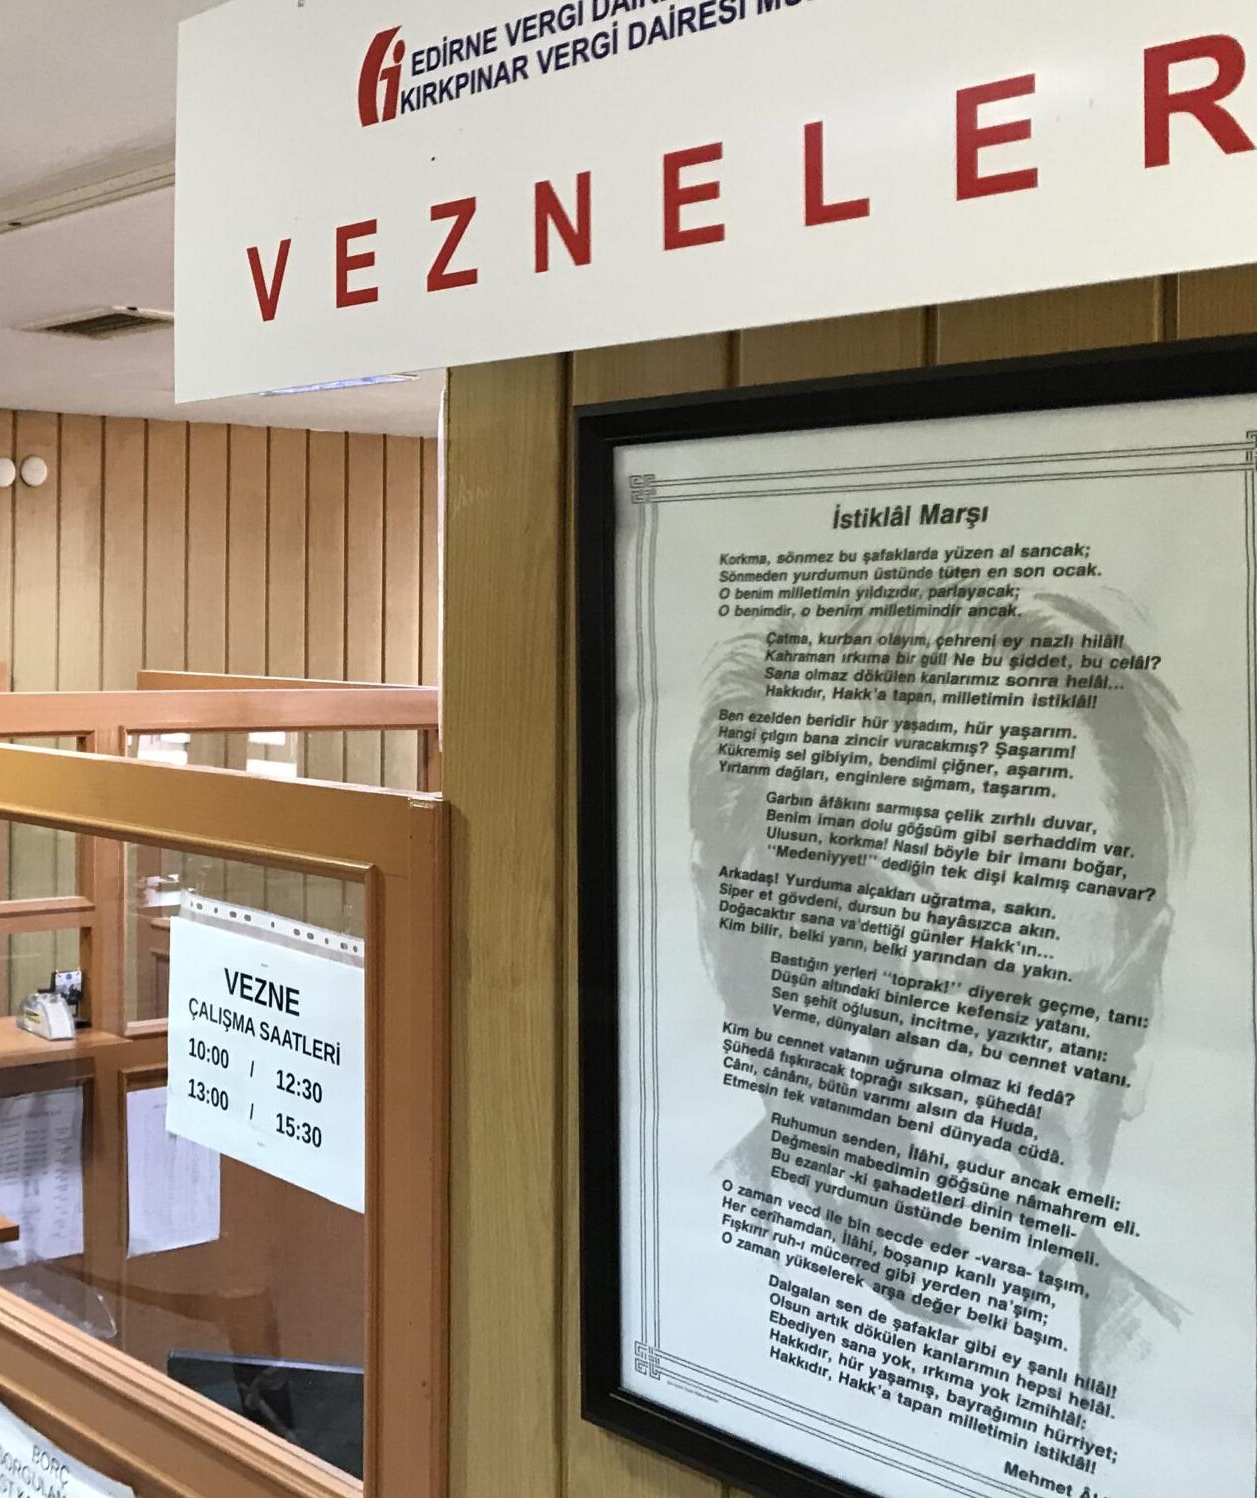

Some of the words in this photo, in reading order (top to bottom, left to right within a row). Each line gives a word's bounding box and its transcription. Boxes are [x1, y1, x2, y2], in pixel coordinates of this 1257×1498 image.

[401, 55, 529, 115] KIRKPINAR
[537, 20, 618, 75] VERGİ
[412, 27, 498, 77] EDİRNE
[247, 34, 1256, 321] VEZNELER
[832, 503, 911, 529] İstiklâl
[919, 503, 988, 529] Marşı
[719, 569, 788, 582] Sönmeden
[792, 568, 868, 584] yurdumun
[873, 566, 933, 580] üstünde
[938, 566, 981, 581] tüten
[986, 567, 1007, 579] en
[1013, 566, 1045, 578] son
[1052, 562, 1101, 577] ocak.
[776, 551, 834, 564] sönmez
[838, 550, 857, 562] bu
[862, 547, 938, 565] şafaklarda
[943, 546, 994, 563] yüzen
[999, 544, 1015, 558] al
[1020, 542, 1090, 558] sancak;
[718, 587, 730, 599] O
[734, 587, 773, 599] benim
[778, 586, 850, 599] milletimin
[855, 585, 922, 601] yıldızıdır,
[927, 583, 1020, 601] parlayacak;
[718, 708, 744, 721] Ben
[748, 711, 801, 725] ezelden
[806, 713, 856, 727] beridir
[861, 715, 889, 729] hür
[893, 719, 957, 735] yaşadım,
[964, 720, 993, 735] hür
[999, 725, 1076, 740] yaşarım.
[718, 725, 756, 743] Hangi
[760, 729, 797, 745] çılgın
[802, 731, 839, 745] bana
[844, 733, 889, 747] zincir
[894, 738, 989, 757] vuracakmış?
[994, 741, 1076, 760] Şaşarım!
[718, 743, 781, 762] Kükremiş
[785, 748, 806, 761] sel
[810, 750, 872, 767] gibiyim,
[878, 753, 937, 770] bendimi
[941, 758, 998, 776] çiğner,
[1006, 764, 1073, 779] aşarım.
[719, 760, 770, 776] Yırtarım
[775, 765, 828, 782] dağları,
[835, 770, 907, 786] enginlere
[911, 775, 975, 794] sığmam,
[982, 780, 1055, 798] taşarım.
[718, 865, 779, 887] Arkadaş!
[785, 873, 852, 893] Yurduma
[856, 882, 915, 902] alçakları
[920, 892, 995, 914] uğratma,
[1003, 902, 1055, 919] sakın.
[718, 899, 796, 921] Doğacaktır
[800, 913, 835, 926] sana
[909, 928, 964, 946] günler
[719, 882, 754, 899] Siper
[758, 889, 773, 901] et
[778, 891, 842, 911] gövdeni,
[847, 899, 896, 918] dursun
[901, 907, 921, 921] bu
[926, 910, 1012, 933] hayâsızca
[1018, 923, 1059, 940] akın.
[719, 917, 745, 932] Kim
[749, 921, 782, 938] bilir,
[789, 926, 824, 942] belki
[828, 935, 866, 952] yarın,
[872, 939, 907, 957] belki
[911, 949, 987, 969] yarından
[993, 958, 1015, 973] da
[1021, 964, 1072, 982] yakın.
[225, 967, 300, 1017] VEZNE
[188, 997, 256, 1037] ÇALIŞMA
[259, 1021, 341, 1067] SAATLERİ
[722, 1021, 749, 1038] Kim
[754, 1027, 772, 1042] bu
[776, 1034, 824, 1053] cennet
[829, 1046, 880, 1066] vatanın
[884, 1058, 943, 1079] uğruna
[950, 1069, 1001, 1090] olmaz
[1006, 1079, 1021, 1094] ki
[1027, 1084, 1075, 1106] fedâ?
[188, 1037, 230, 1070] 10:00
[276, 1069, 323, 1105] 12:30
[722, 1038, 774, 1060] Şühedâ
[849, 1067, 902, 1091] toprağı
[907, 1082, 968, 1105] sıksan,
[975, 1094, 1042, 1120] şühedâ!
[723, 1055, 757, 1075] Cânı,
[818, 1076, 857, 1098] bütün
[863, 1091, 910, 1111] varımı
[916, 1101, 957, 1119] alsın
[963, 1110, 984, 1125] da
[990, 1115, 1038, 1141] Huda,
[188, 1078, 230, 1112] 13:00
[275, 1112, 323, 1149] 15:30
[722, 1073, 778, 1096] Etmesin
[783, 1087, 805, 1102] tek
[809, 1095, 891, 1125] vatanımdan
[896, 1114, 934, 1134] beni
[939, 1124, 1012, 1152] dünyada
[1017, 1144, 1064, 1165] cüdâ.
[768, 1274, 830, 1305] Dalgalan
[835, 1299, 862, 1316] sen
[867, 1308, 887, 1324] de
[892, 1318, 959, 1345] şafaklar
[964, 1339, 996, 1358] gibi
[1002, 1352, 1022, 1369] ey
[1027, 1360, 1067, 1382] şanlı
[769, 1292, 810, 1316] Olsun
[815, 1310, 848, 1330] artık
[854, 1322, 916, 1352] dökülen
[922, 1343, 1009, 1382] kanlarımın
[1015, 1373, 1062, 1400] hepsi
[1068, 1391, 1114, 1419] helâl.
[769, 1309, 835, 1343] Ebediyen
[840, 1337, 876, 1358] sana
[881, 1351, 915, 1374] yok,
[922, 1365, 974, 1390] ırkıma
[979, 1383, 1010, 1403] yok
[769, 1327, 831, 1363] Hakkıdır,
[838, 1352, 864, 1372] hür
[868, 1366, 939, 1400] yaşamış,
[946, 1388, 1037, 1433] bayrağımın
[1043, 1423, 1117, 1464] hürriyet;
[769, 1345, 831, 1381] Hakkıdır,
[897, 1392, 942, 1418] tapan
[948, 1412, 1028, 1450] milletimin
[1033, 1440, 1096, 1474] istiklâl!
[1004, 1461, 1072, 1497] Mehmet
